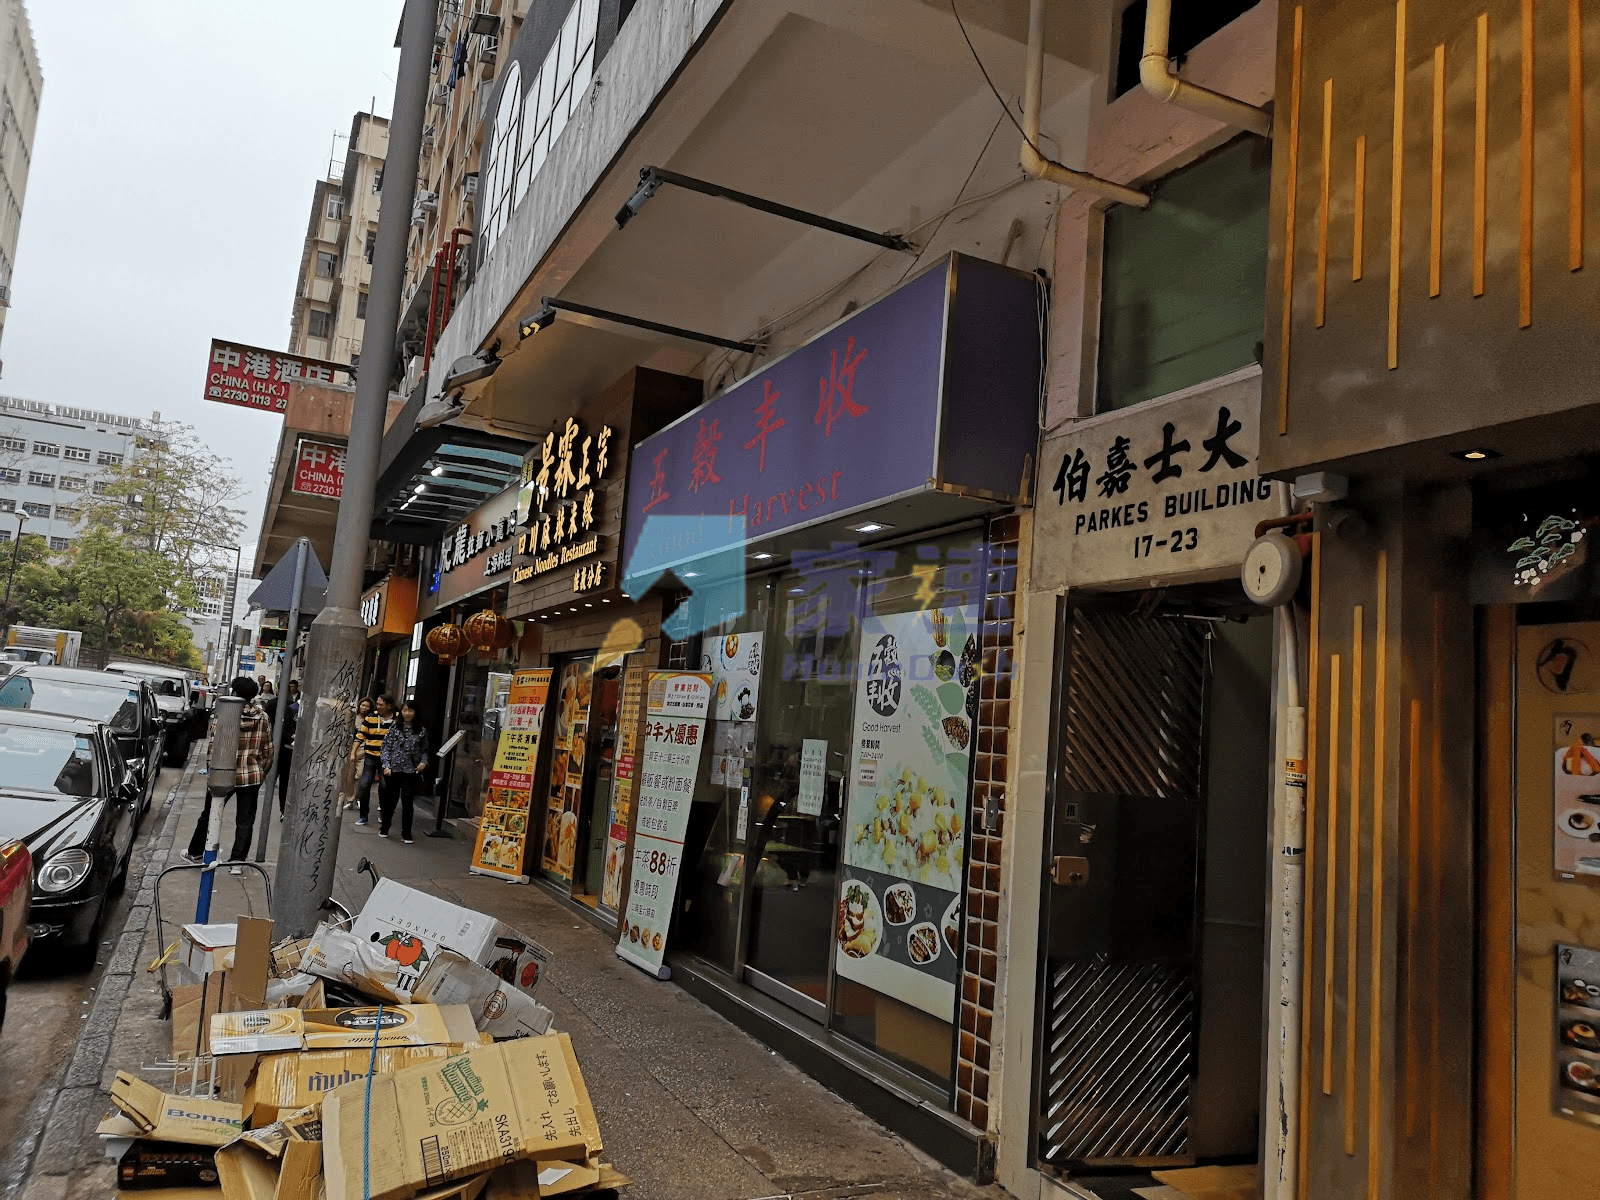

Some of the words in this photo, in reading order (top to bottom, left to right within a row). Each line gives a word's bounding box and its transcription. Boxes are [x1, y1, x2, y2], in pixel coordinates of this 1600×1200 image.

[210, 373, 249, 391] CHINA
[252, 381, 285, 397] (H.K.)
[223, 389, 249, 402] 2730
[250, 392, 271, 406] 1113
[300, 470, 335, 485] CHINA
[313, 483, 335, 495] 2730
[728, 470, 843, 535] Harvest
[1075, 501, 1149, 536] PARKES
[1164, 477, 1272, 519] BUILDING
[560, 535, 598, 564] Restaurant
[1133, 527, 1199, 559] 17-23
[862, 721, 879, 733] Good
[880, 722, 901, 734] Harvest
[389, 914, 447, 942] ORANGES
[440, 1062, 474, 1104] Ramune
[454, 1056, 485, 1096] Hawaiian
[563, 1107, 583, 1138] 先出し
